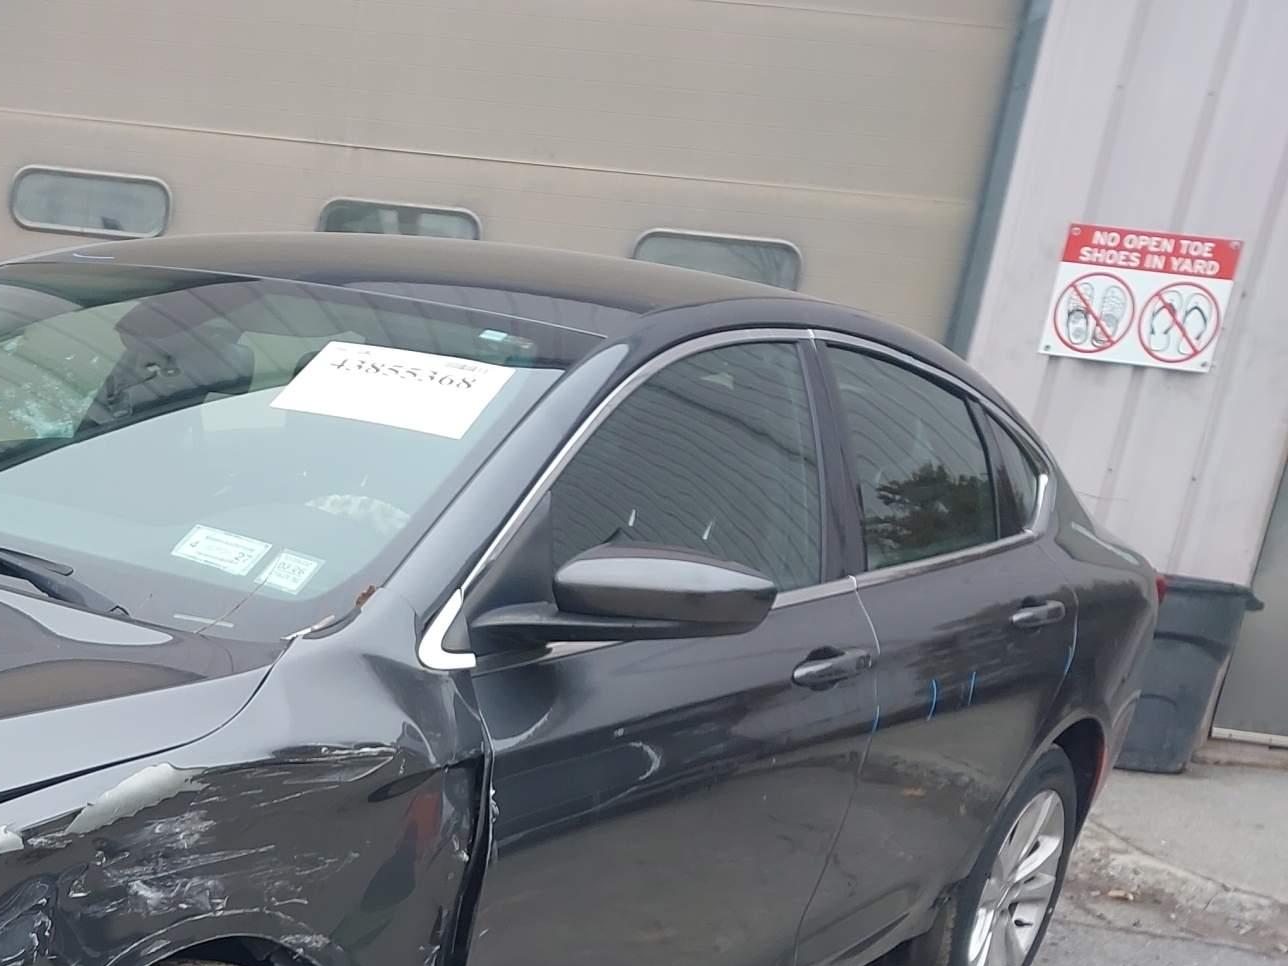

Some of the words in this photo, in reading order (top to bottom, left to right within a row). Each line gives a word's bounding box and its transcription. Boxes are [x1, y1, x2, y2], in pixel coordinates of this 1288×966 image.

[1091, 230, 1121, 248] NO
[1123, 234, 1175, 254] OPEN
[1180, 239, 1216, 258] TOE
[1079, 247, 1141, 267] SHOES
[1144, 253, 1166, 270] IN
[1171, 257, 1220, 275] YARD
[329, 358, 476, 389] 43855368
